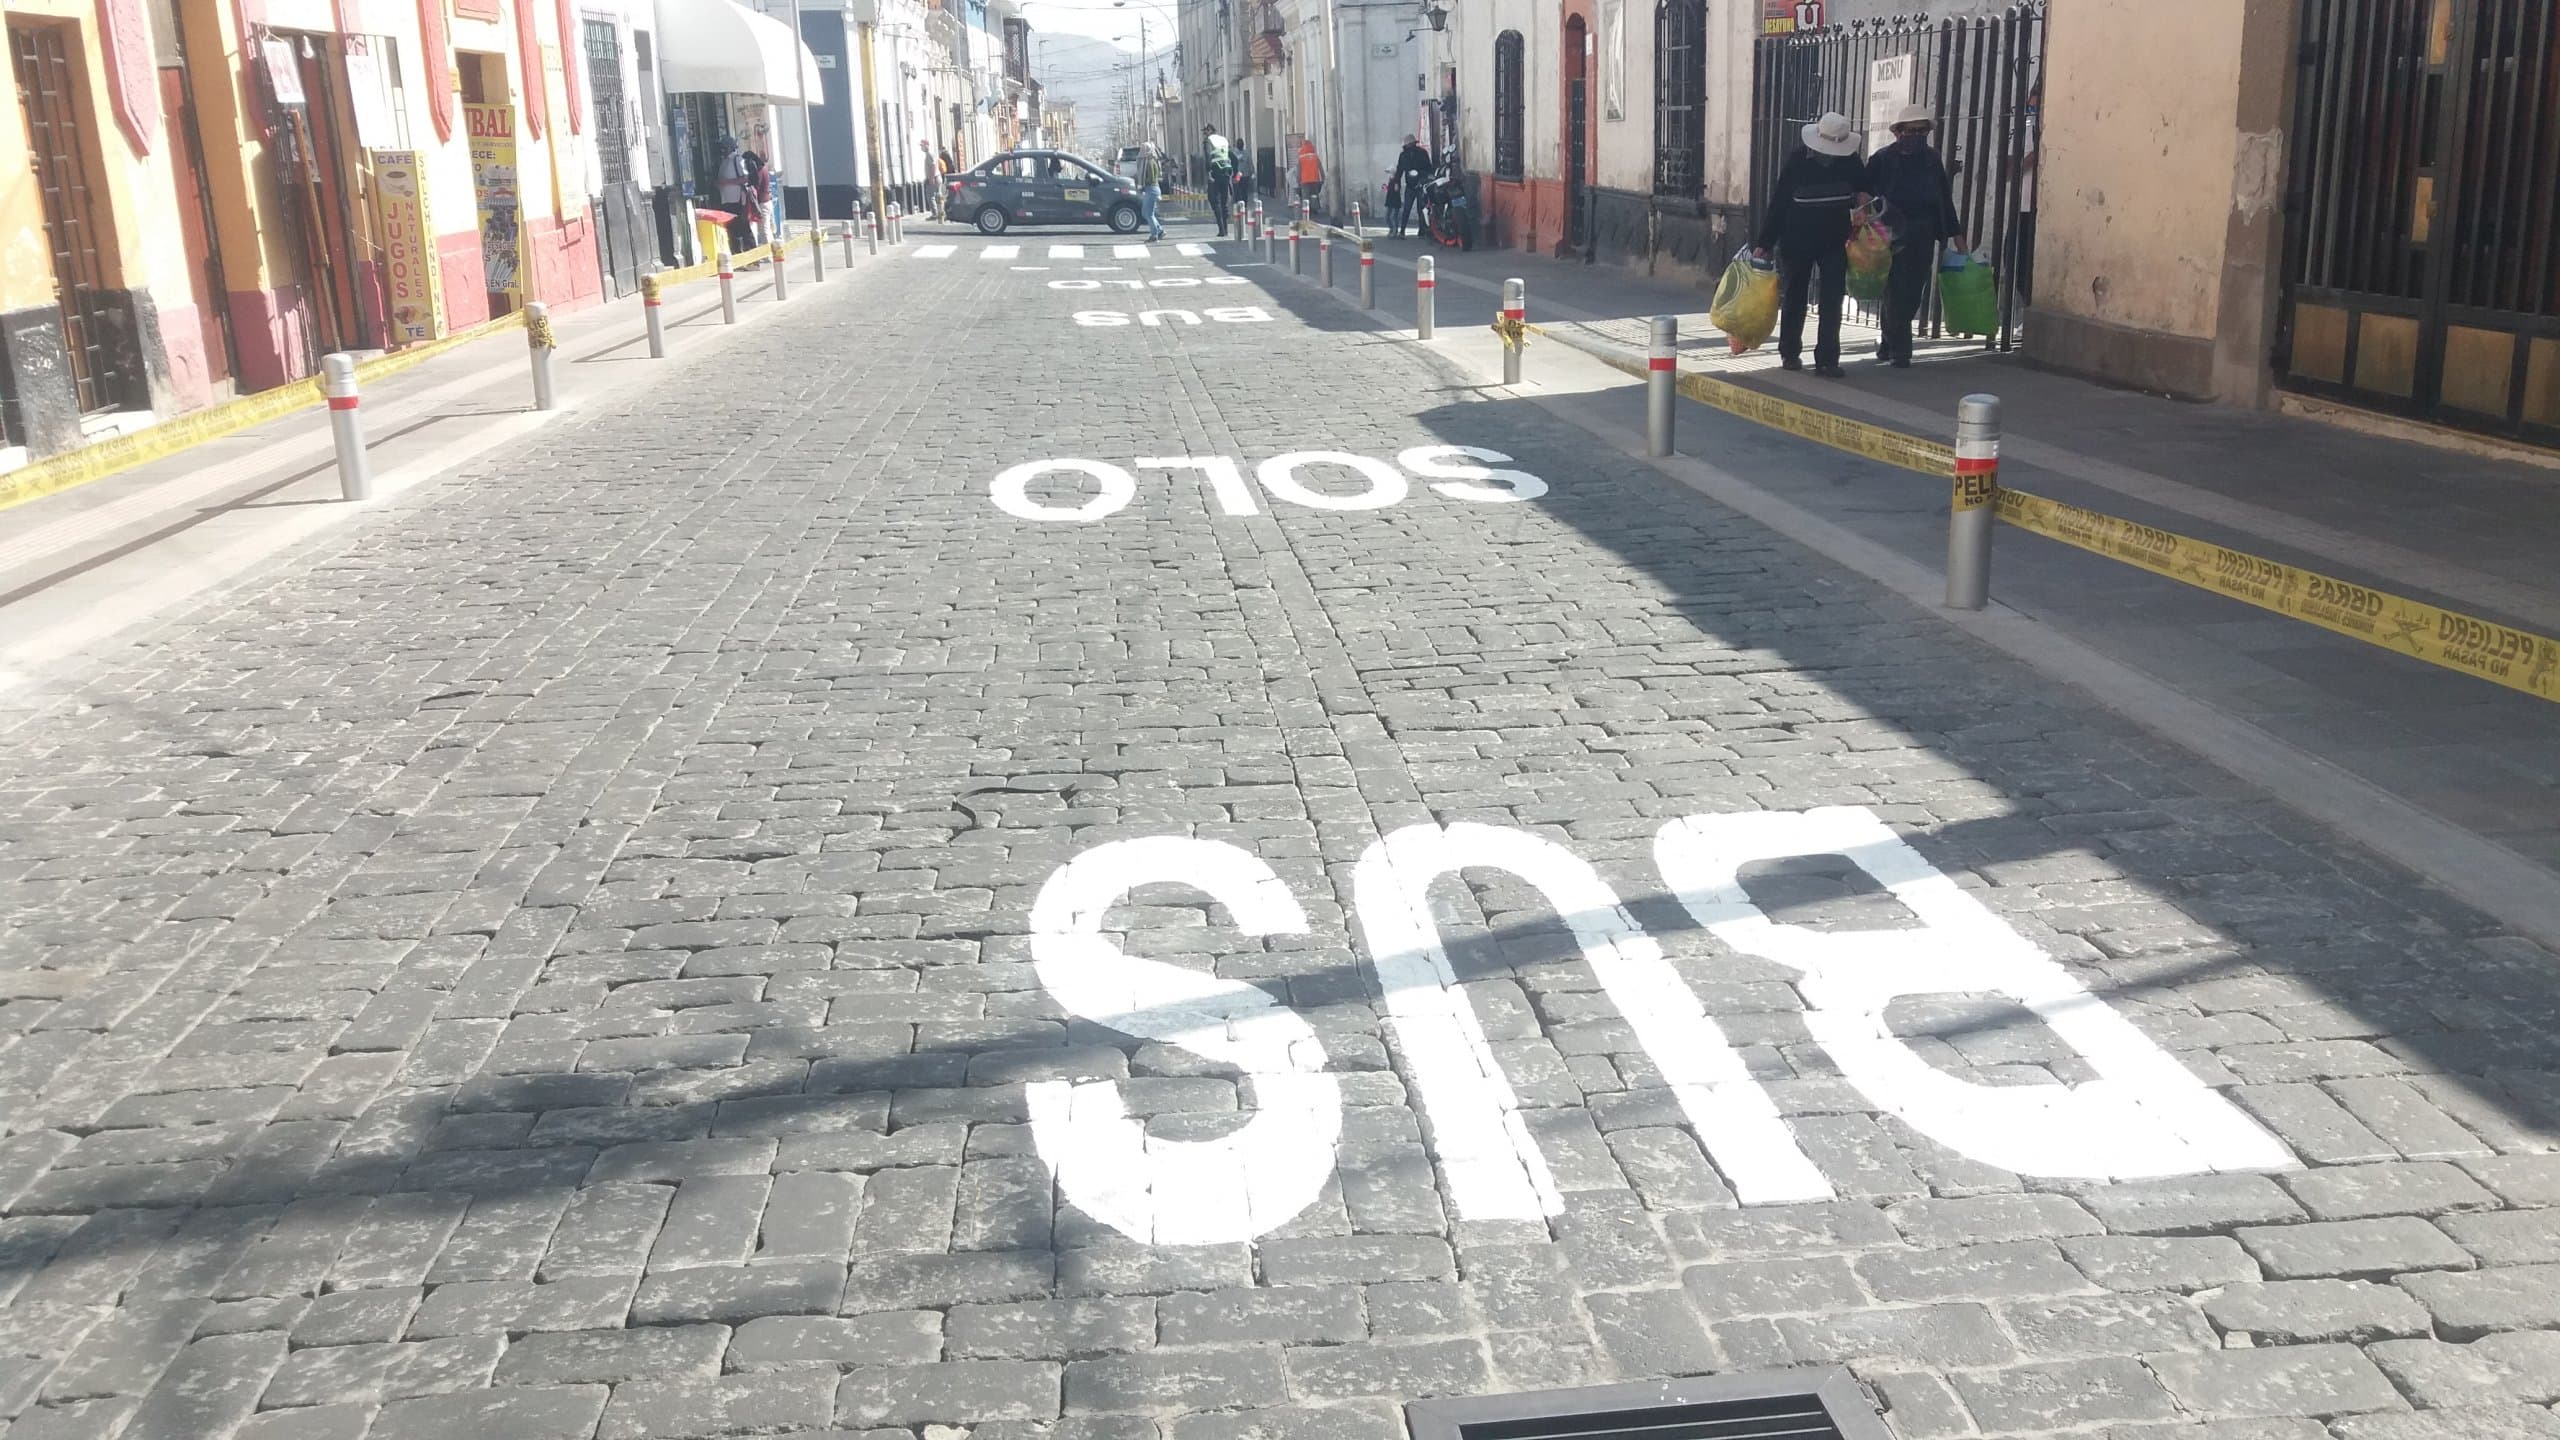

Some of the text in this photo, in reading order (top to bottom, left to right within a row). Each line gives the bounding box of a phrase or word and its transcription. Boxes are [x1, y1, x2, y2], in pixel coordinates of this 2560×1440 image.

[387, 202, 409, 299] JUGOS
[405, 202, 424, 298] NATURALES
[1048, 276, 1251, 290] SOLO
[1072, 306, 1275, 327] BUS
[990, 444, 1549, 522] SOLO
[1026, 804, 2304, 1247] BUS
